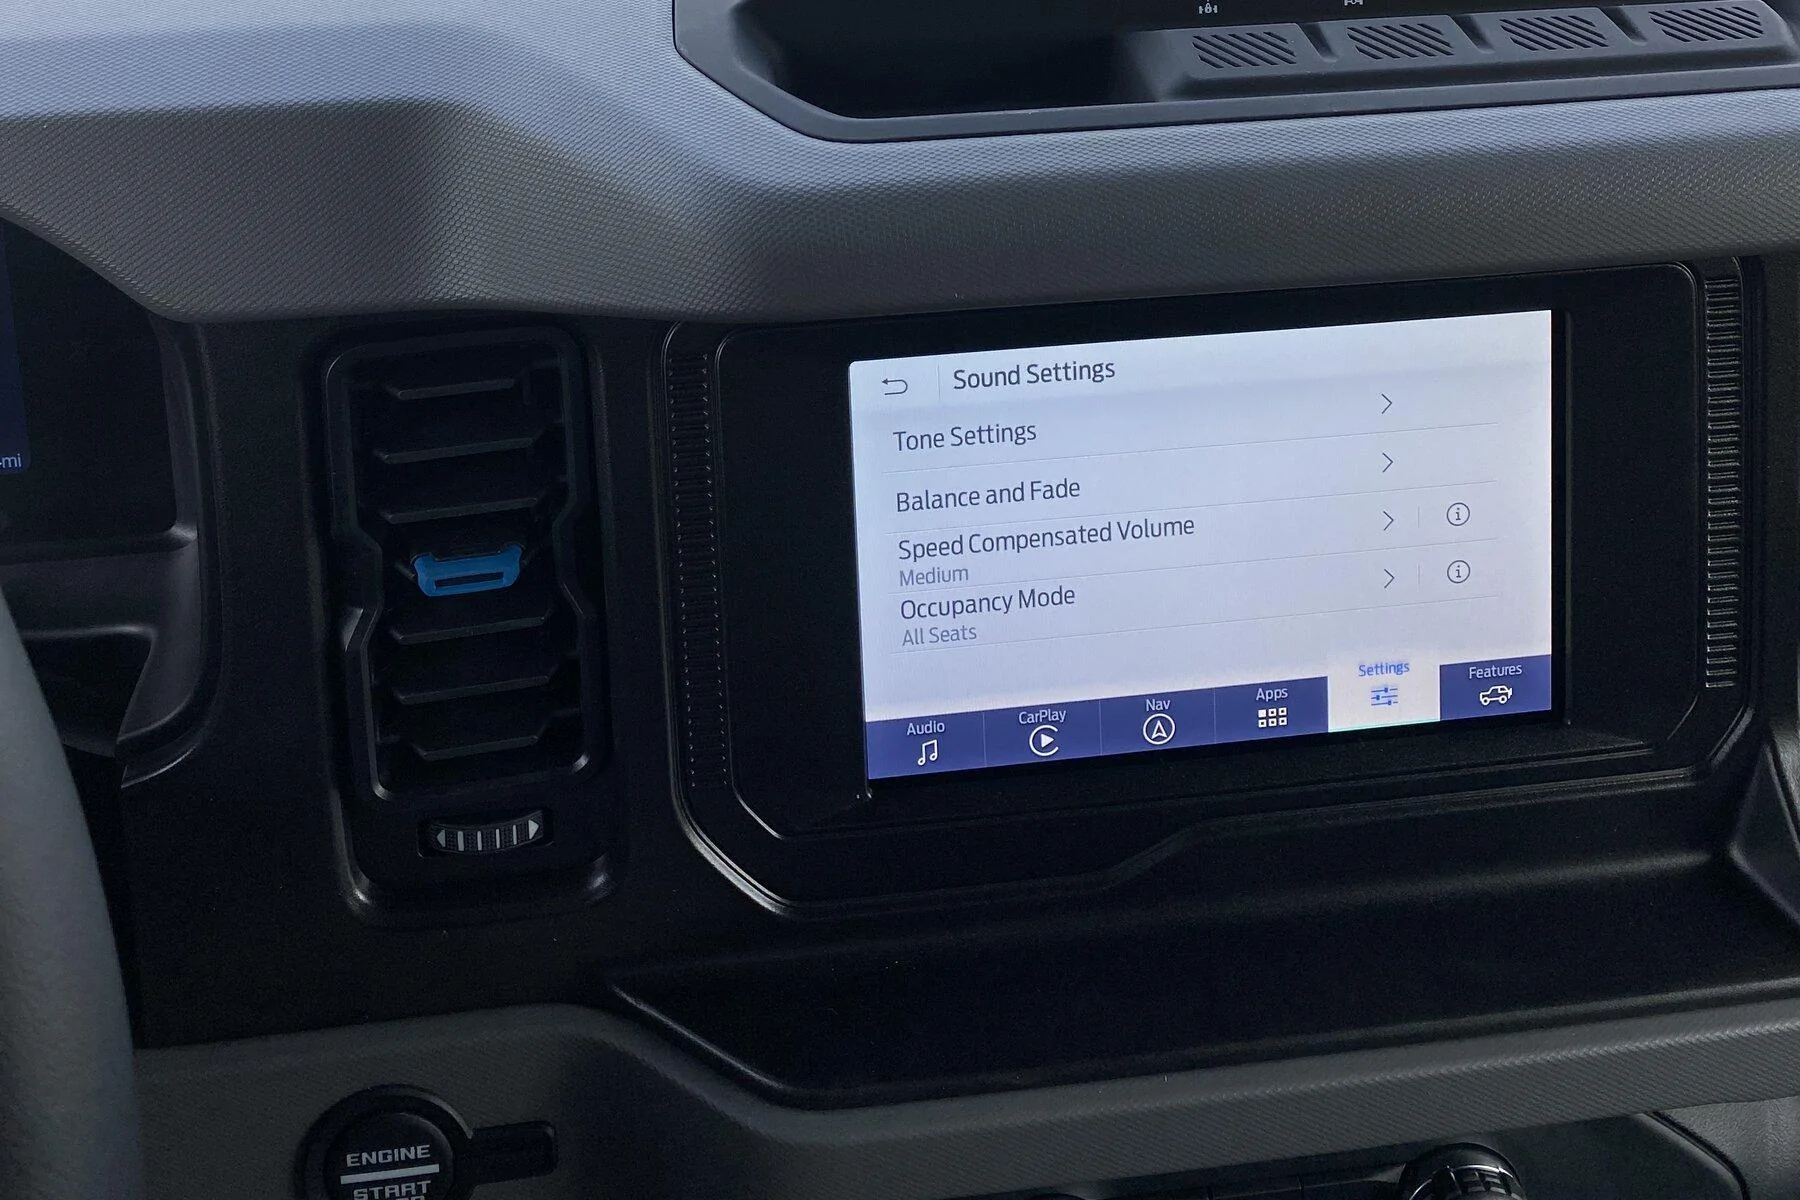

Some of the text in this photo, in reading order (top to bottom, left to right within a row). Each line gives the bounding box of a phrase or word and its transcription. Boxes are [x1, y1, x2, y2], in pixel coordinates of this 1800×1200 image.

[953, 360, 1116, 390] Sound Settings
[893, 423, 1037, 452] Tone Settings
[896, 478, 1081, 513] Balance and Fade
[898, 517, 1195, 563] Speed Compensated Volume
[899, 565, 970, 587] Medium
[900, 585, 1076, 620] Occupancy Mode
[901, 624, 977, 646] All Seats
[1358, 660, 1410, 677] Settings
[1469, 663, 1523, 680] Features
[1146, 698, 1171, 712] Nav
[1255, 686, 1289, 702] Apps
[1018, 707, 1067, 725] CarPlay
[906, 719, 945, 736] Audio
[346, 1144, 431, 1167] ENGINE
[353, 1180, 432, 1200] START
